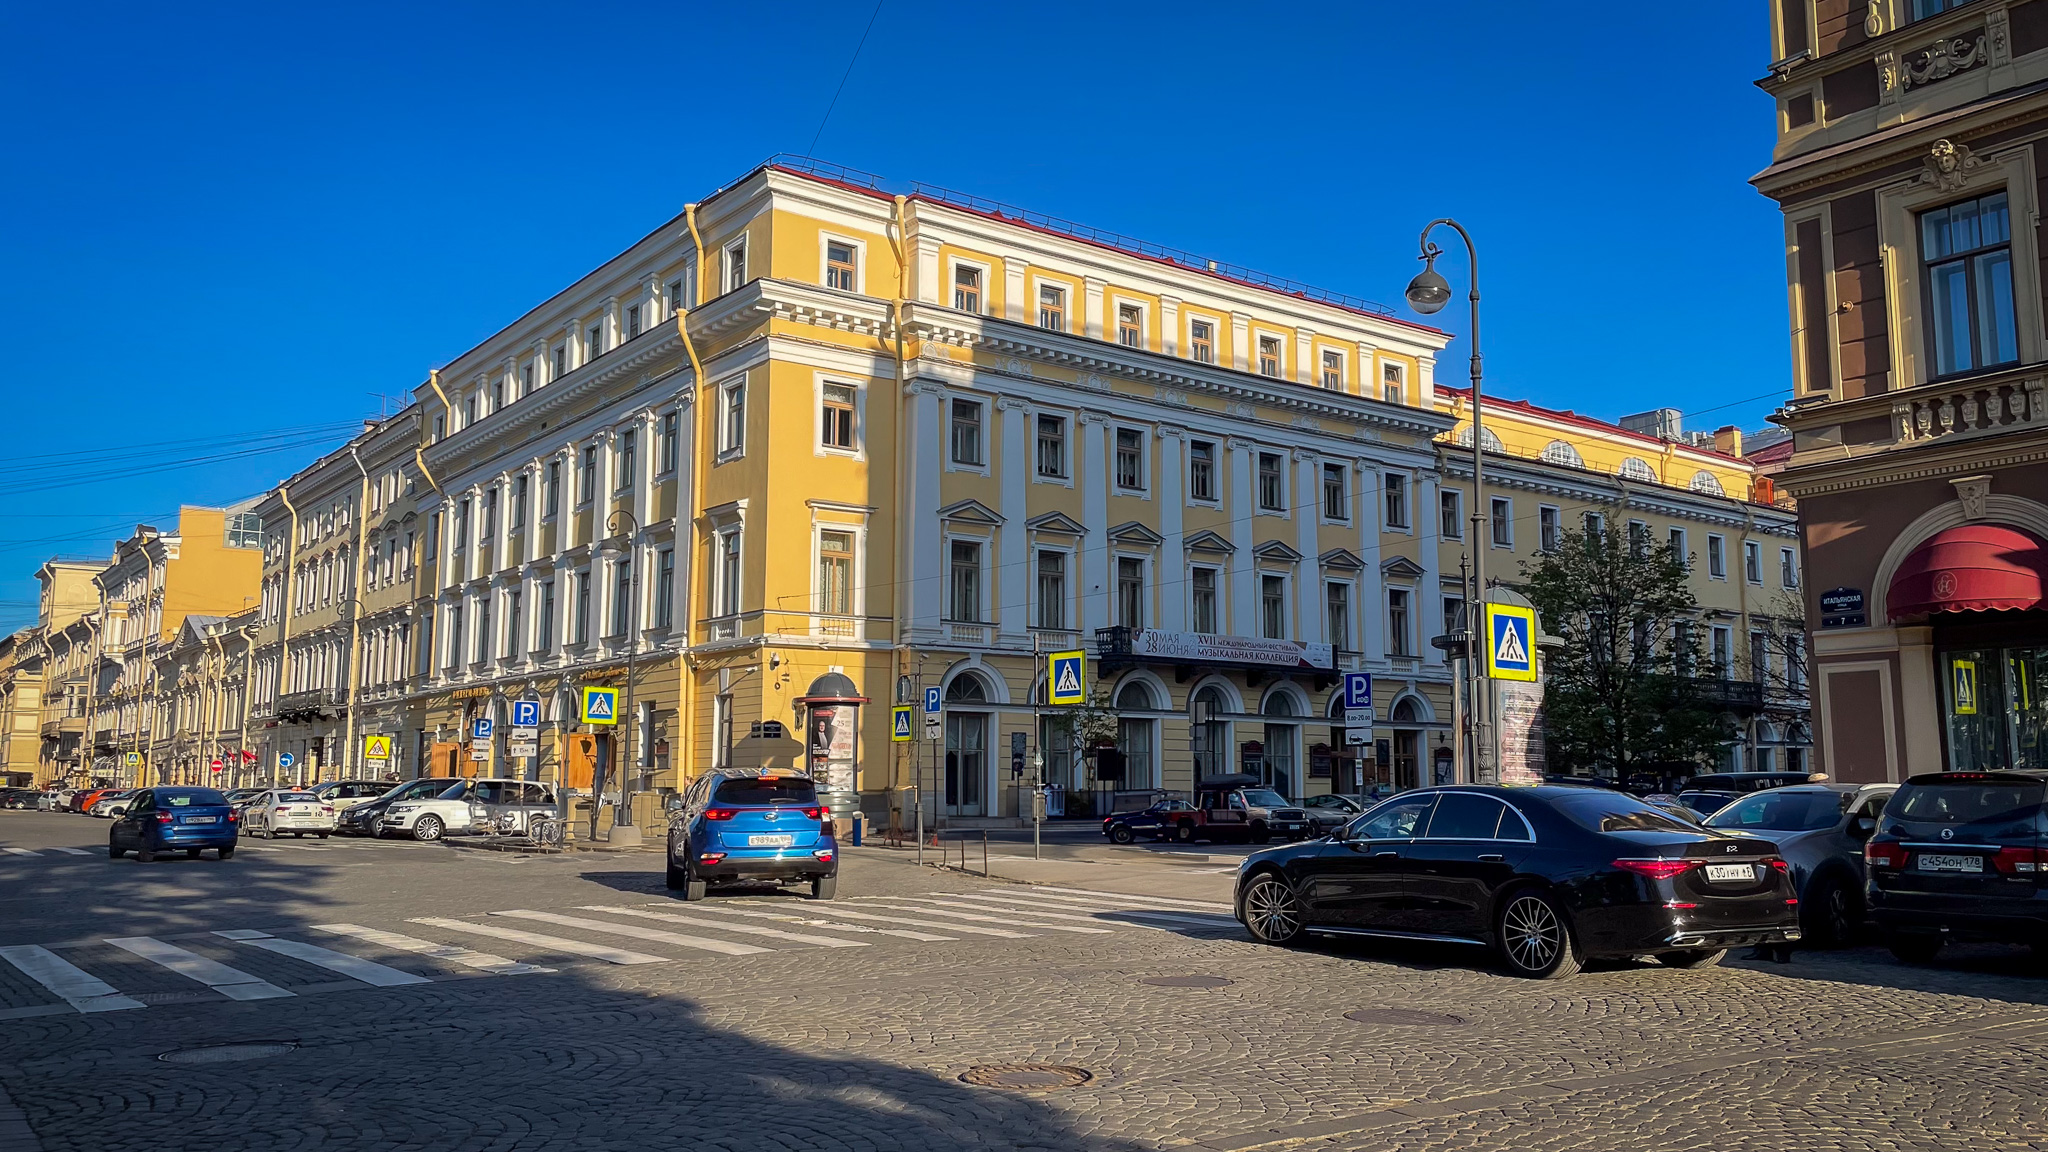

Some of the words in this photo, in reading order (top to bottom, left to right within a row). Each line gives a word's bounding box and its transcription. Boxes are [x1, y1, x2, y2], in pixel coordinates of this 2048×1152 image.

[1823, 595, 1861, 604] ИТАЛЬЯНСКАЯ
[1841, 617, 1845, 625] 7
[1145, 631, 1159, 641] 30
[1160, 633, 1180, 643] МАЯ
[1198, 634, 1216, 645] XVII
[1217, 640, 1268, 650] МЕЖДУНАРОДНЫЙ
[1268, 643, 1298, 652] ФЕСТИВАЛЬ
[1145, 641, 1158, 653] 28
[1160, 643, 1189, 655] ИЮНЯ
[1198, 648, 1254, 660] МУЗЫКАЛЬНАЯ
[1255, 652, 1299, 664] КОЛЛЕКЦИЯ
[1352, 676, 1367, 704] P
[929, 690, 938, 710] P
[520, 703, 535, 723] P
[478, 720, 490, 736] P
[1920, 857, 1962, 868] С454ОН
[1964, 856, 1981, 865] 178
